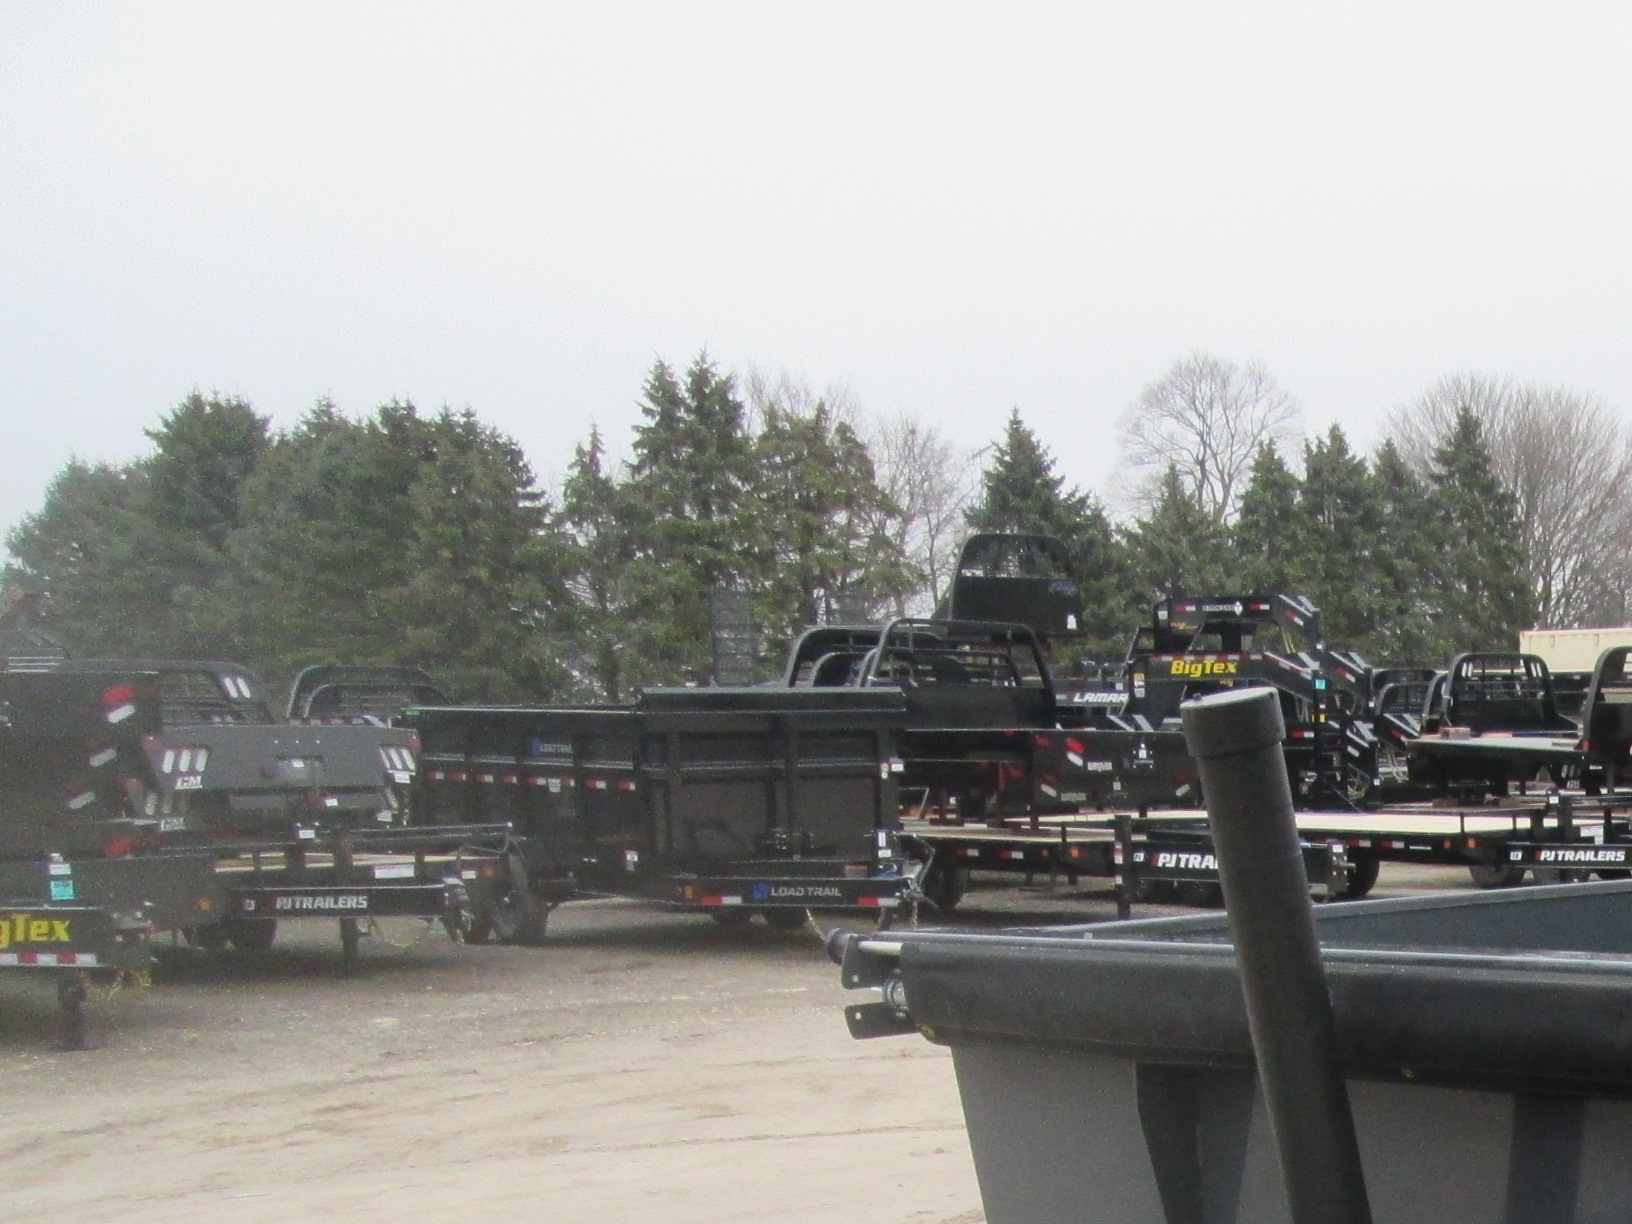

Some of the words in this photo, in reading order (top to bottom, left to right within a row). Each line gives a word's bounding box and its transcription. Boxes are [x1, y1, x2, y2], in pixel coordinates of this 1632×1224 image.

[1170, 660, 1238, 678] BigTex
[1072, 692, 1130, 703] LAMAR
[1157, 853, 1178, 868] PJ
[1540, 851, 1555, 861] PJ
[1556, 850, 1626, 862] TRAILERS
[770, 886, 805, 897] LOAD
[806, 886, 842, 897] TRAIL
[276, 897, 292, 909] PJ
[295, 896, 368, 910] TRAILERS
